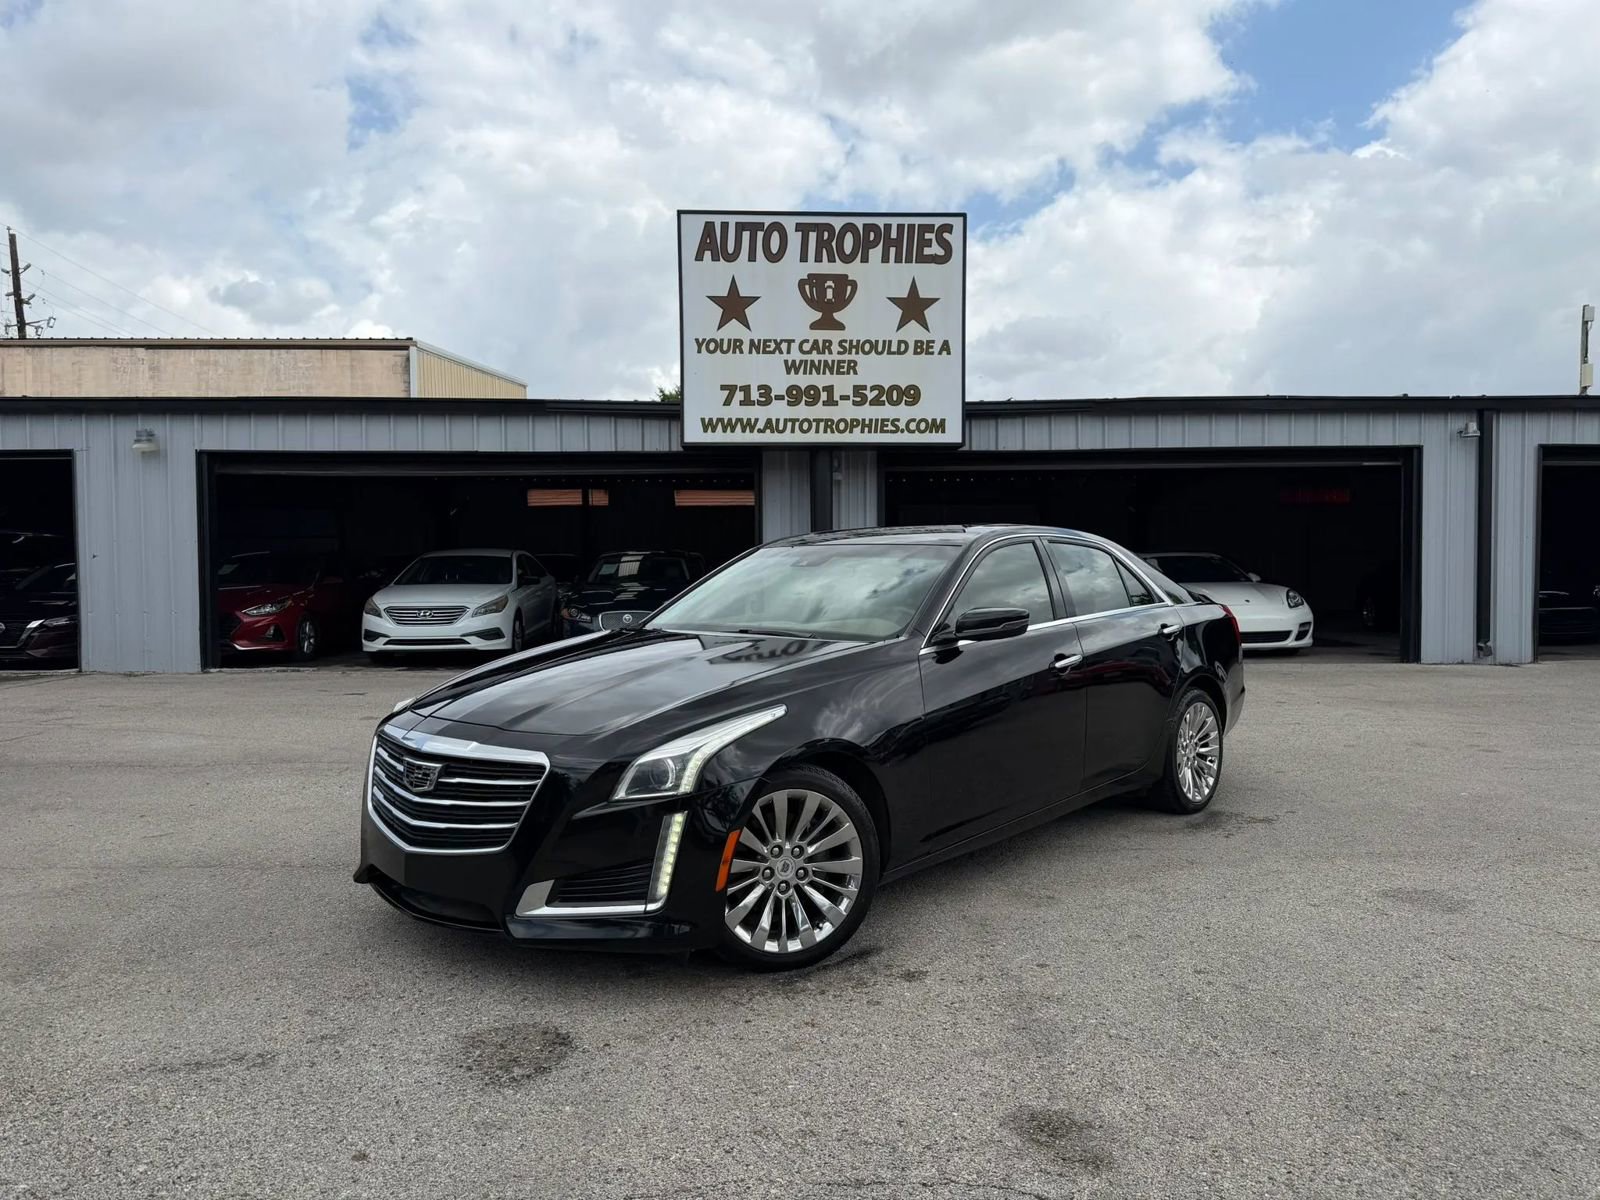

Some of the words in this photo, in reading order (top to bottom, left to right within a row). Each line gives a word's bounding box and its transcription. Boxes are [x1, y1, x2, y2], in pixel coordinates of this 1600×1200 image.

[695, 221, 788, 263] AUTO
[795, 222, 953, 265] TROPHIES
[694, 338, 744, 355] YOUR
[748, 338, 795, 355] NEXT
[798, 338, 834, 355] CAR
[837, 339, 909, 356] SHOULD
[912, 339, 935, 355] BE
[937, 340, 952, 355] A
[783, 359, 859, 376] WINNER
[719, 384, 922, 407] 713-991-5209
[700, 417, 947, 435] WWW.AUTOTROPHIES.COM
